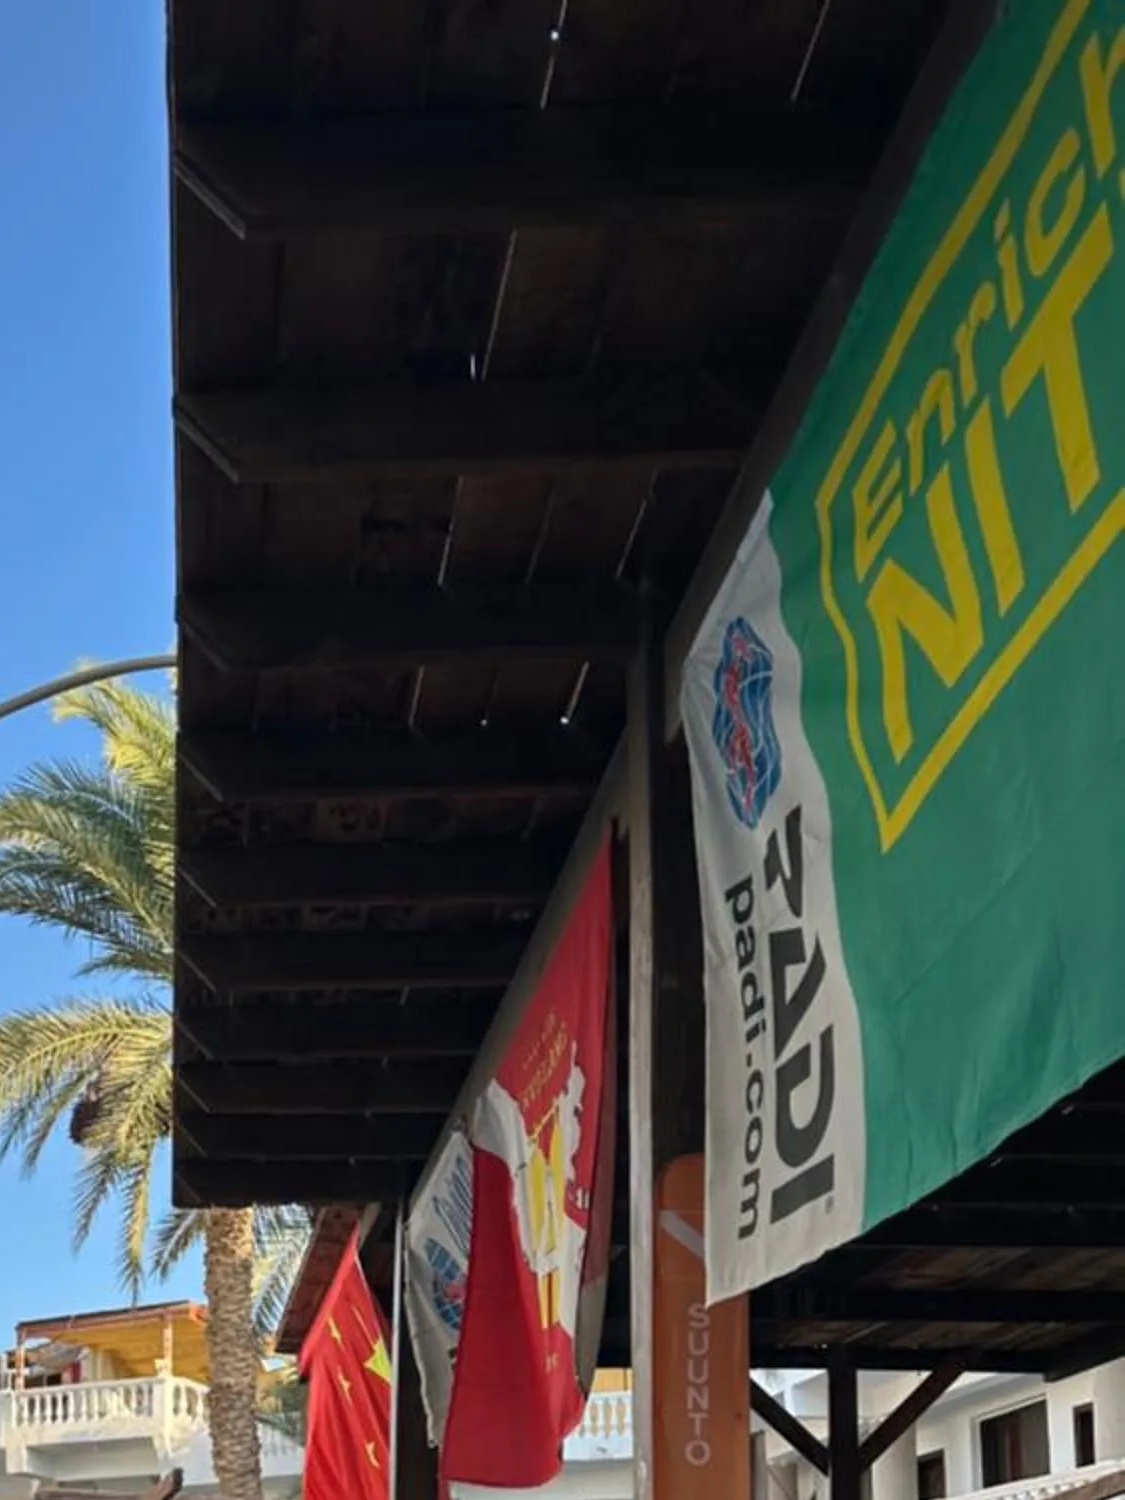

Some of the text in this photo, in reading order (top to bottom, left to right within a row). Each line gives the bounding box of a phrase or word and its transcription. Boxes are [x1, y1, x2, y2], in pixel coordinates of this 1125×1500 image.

[865, 166, 1125, 766] NIT
[723, 873, 766, 1241] padi.com
[763, 804, 835, 1225] PADI
[684, 1302, 712, 1466] SUUNTO
